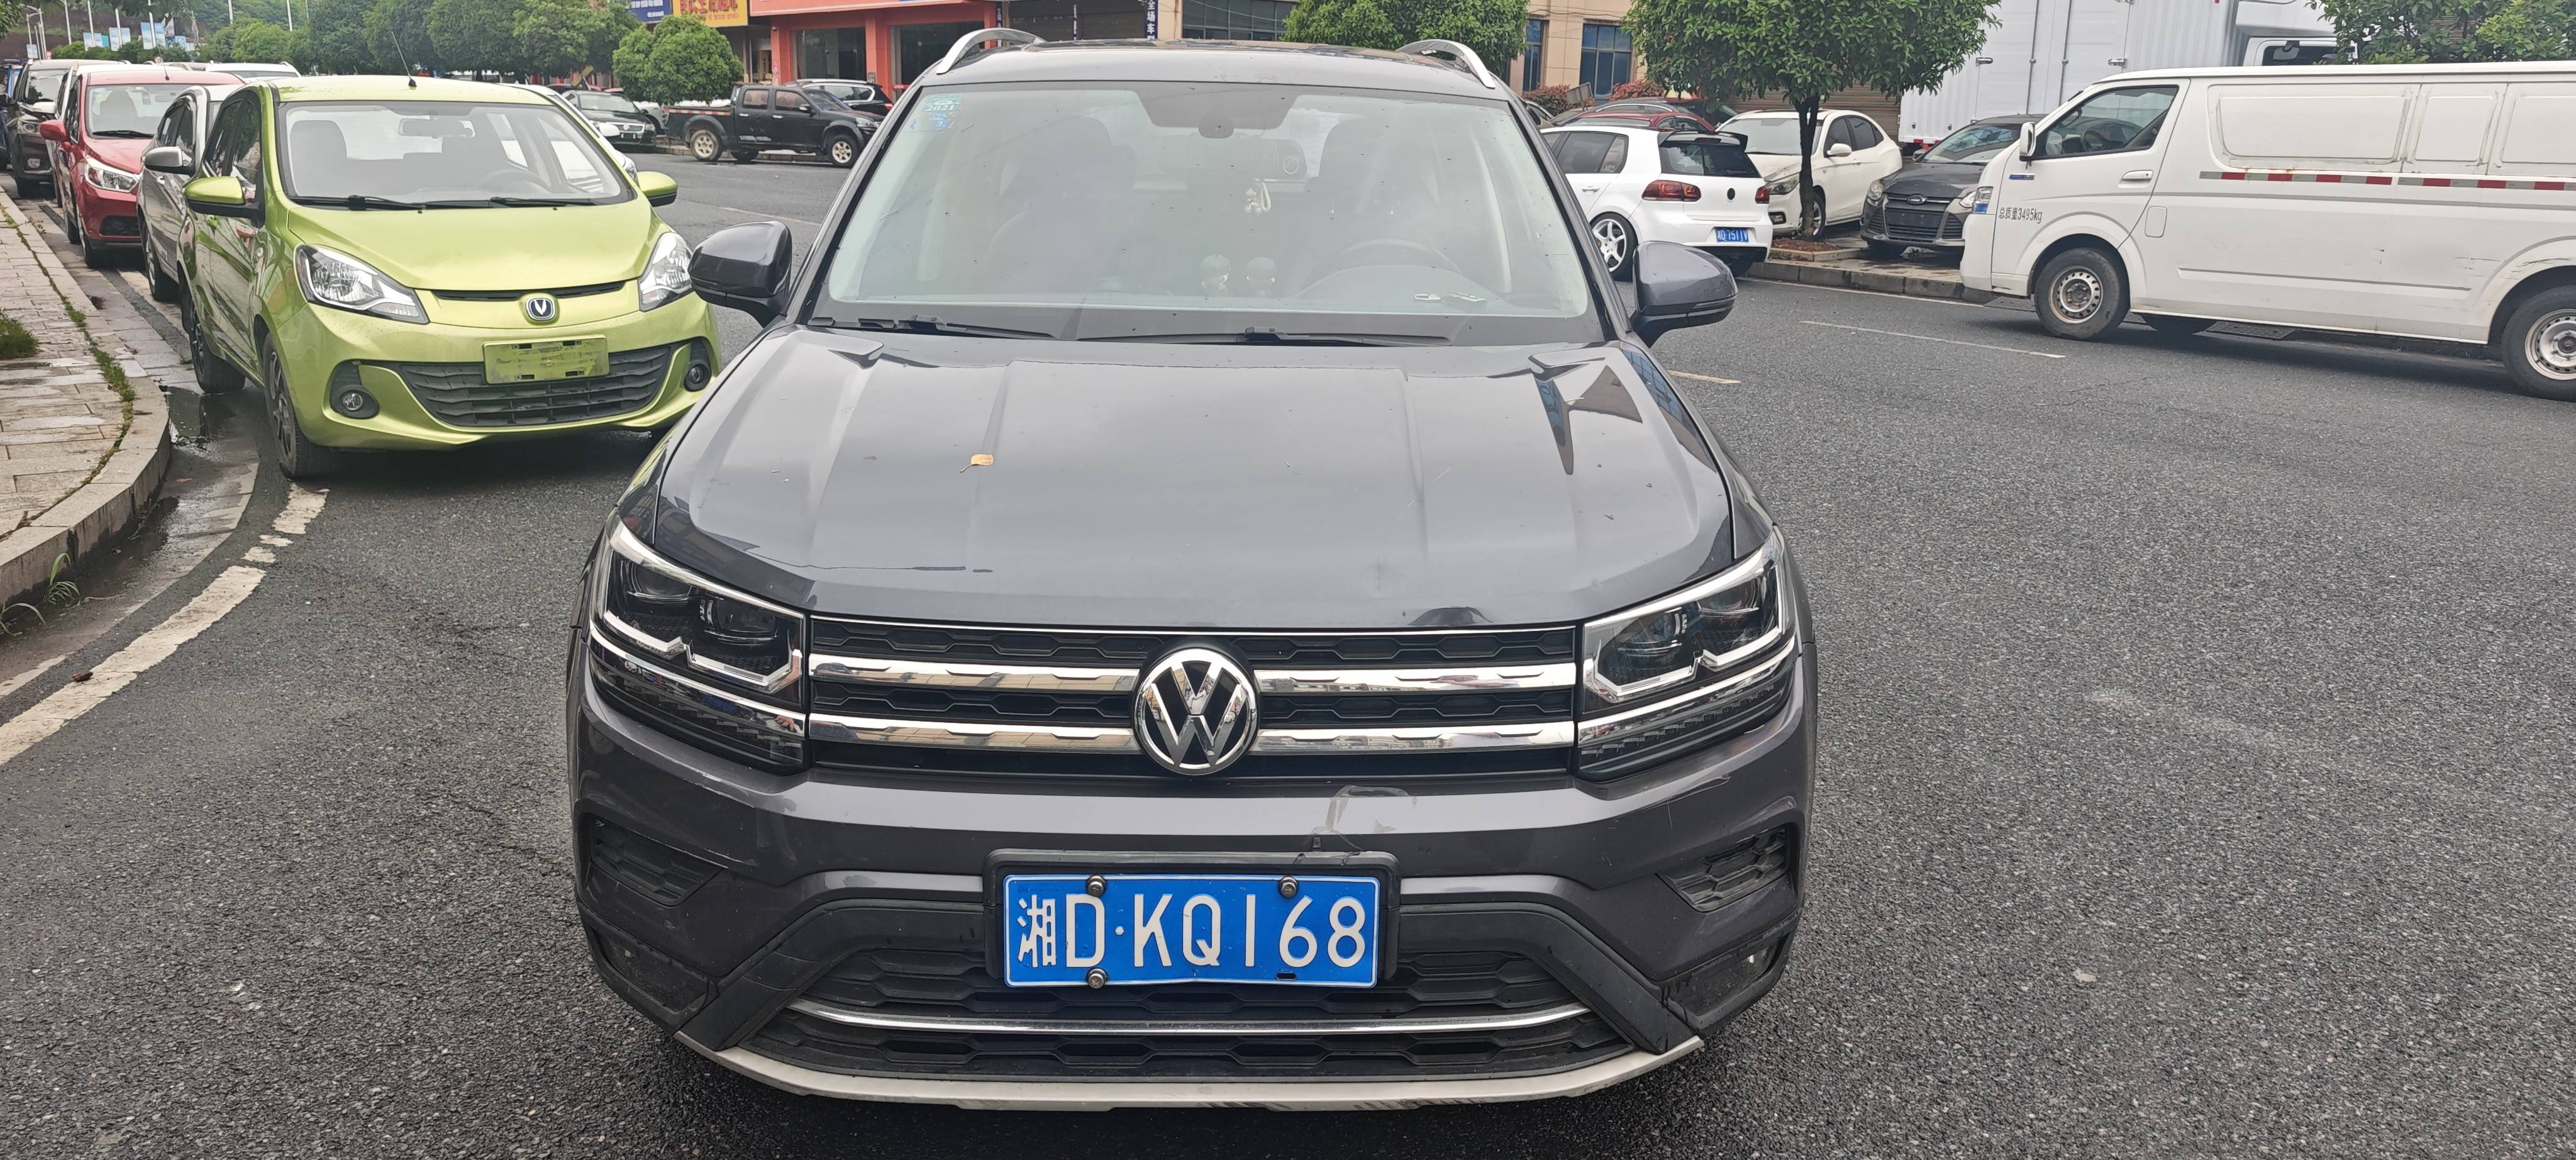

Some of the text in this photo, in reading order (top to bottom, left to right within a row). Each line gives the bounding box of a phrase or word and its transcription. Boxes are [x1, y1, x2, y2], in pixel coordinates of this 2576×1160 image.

[1999, 207, 2043, 224] 总质量3495kg
[1018, 893, 1366, 969] 湘D·KQ168
